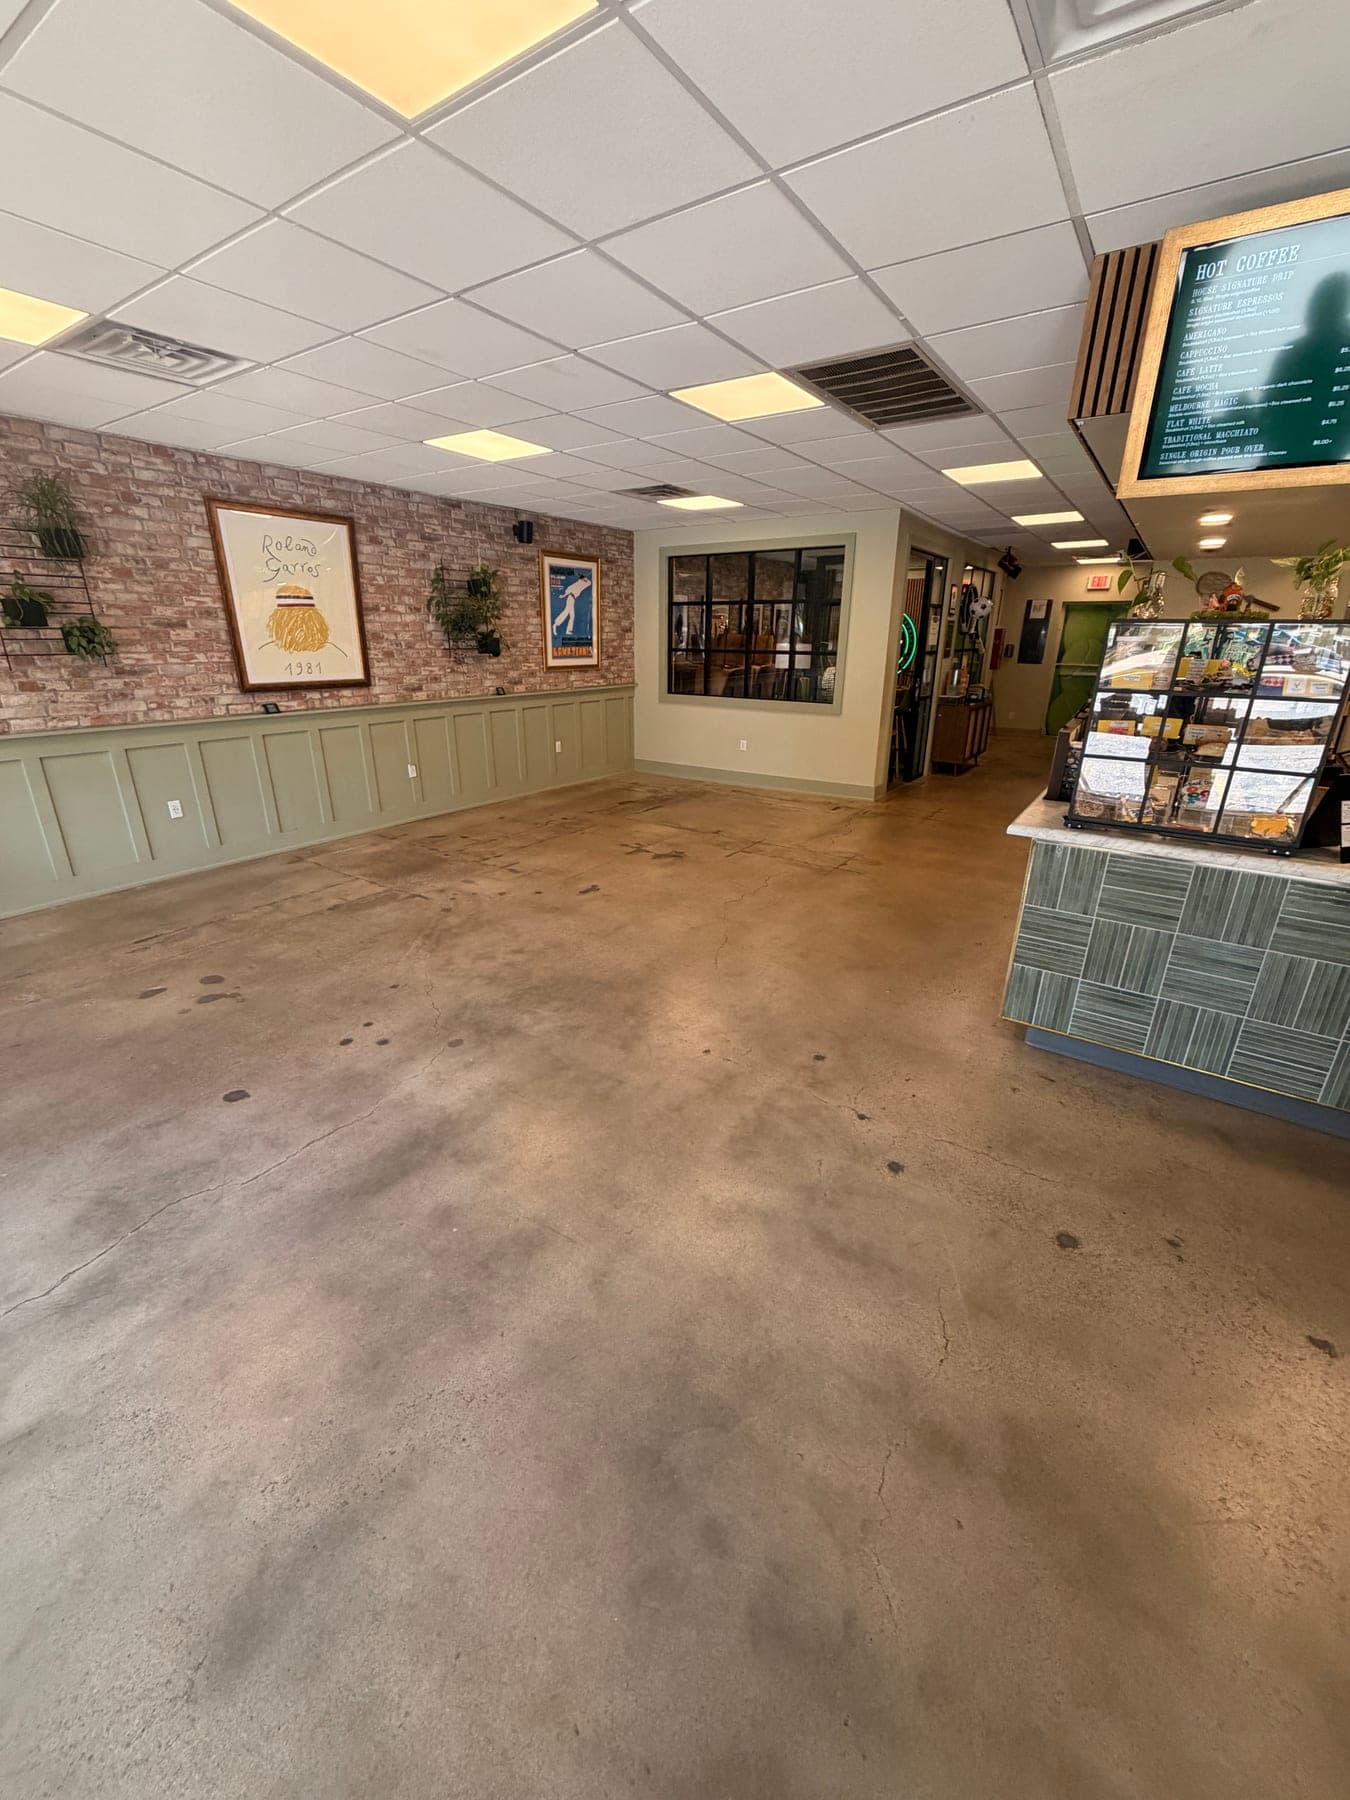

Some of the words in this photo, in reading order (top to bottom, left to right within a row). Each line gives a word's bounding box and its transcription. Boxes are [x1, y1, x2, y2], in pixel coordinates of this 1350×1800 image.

[1195, 259, 1228, 281] HOT
[1236, 244, 1301, 273] COFFEE
[1191, 285, 1217, 298] HOUSE
[1222, 275, 1269, 292] SIGNATURE
[1272, 270, 1295, 282] DRIP
[1187, 301, 1233, 317] SIGNATURE
[1236, 292, 1285, 308] ESPRESSOS
[1183, 327, 1228, 341] AMERICANO
[1180, 344, 1228, 359] CAPPUCCINO
[1176, 367, 1196, 378] CAFE
[1199, 363, 1224, 375] LATTE
[1172, 385, 1192, 395] CAFE
[1195, 382, 1219, 393] MOCHA
[1169, 400, 1210, 412] MELBOURNE
[1214, 397, 1239, 407] MAGIC
[1166, 419, 1185, 428] FLAT
[1188, 416, 1212, 425] WHITE
[1163, 432, 1212, 444] TRADITIONAL
[1215, 427, 1259, 439] MACCHIATO
[1160, 450, 1187, 460] SINGLE
[1189, 448, 1218, 458] ORIGIN
[1220, 446, 1241, 456] POUR
[1243, 444, 1264, 453] OVER
[262, 534, 318, 563] Roland
[263, 557, 321, 583] Garros
[1091, 575, 1109, 588] EXIT
[284, 661, 322, 676] 1981
